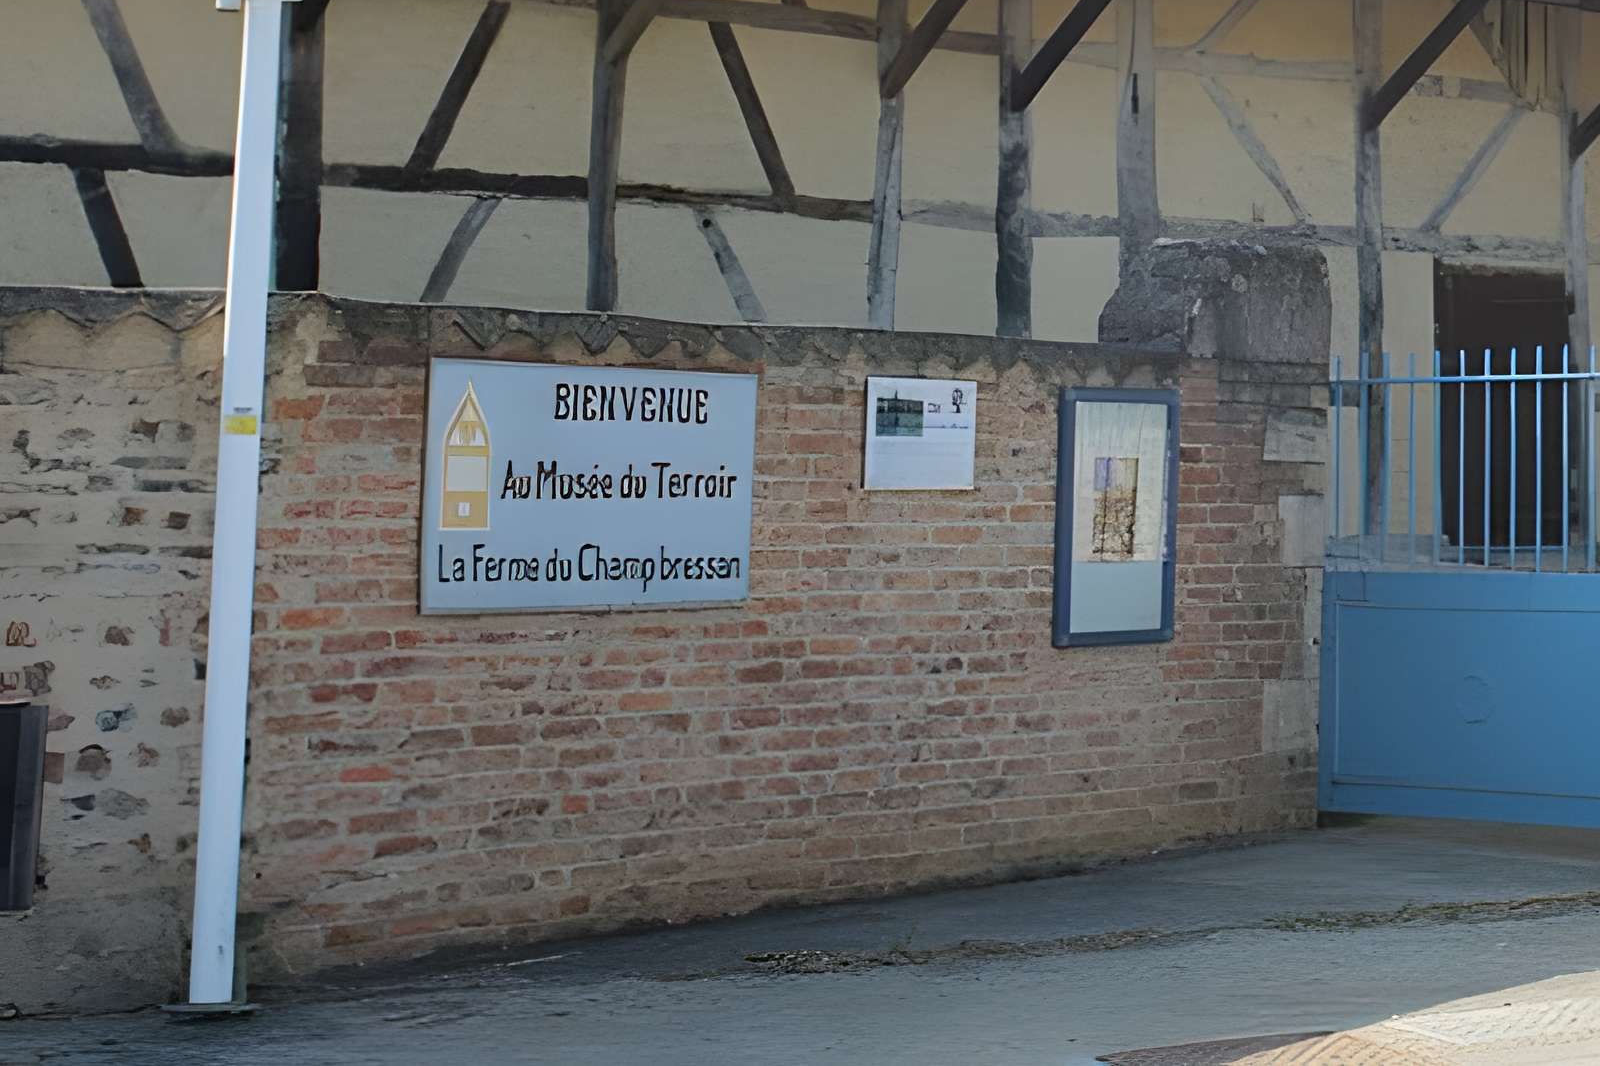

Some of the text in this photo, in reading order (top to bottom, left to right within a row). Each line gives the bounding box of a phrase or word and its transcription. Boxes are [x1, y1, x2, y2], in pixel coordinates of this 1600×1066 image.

[554, 382, 709, 425] BIENVENUE
[500, 459, 738, 500] Au Musée du Terroir
[438, 543, 466, 583] La
[472, 543, 540, 582] Ferme
[546, 547, 572, 582] du
